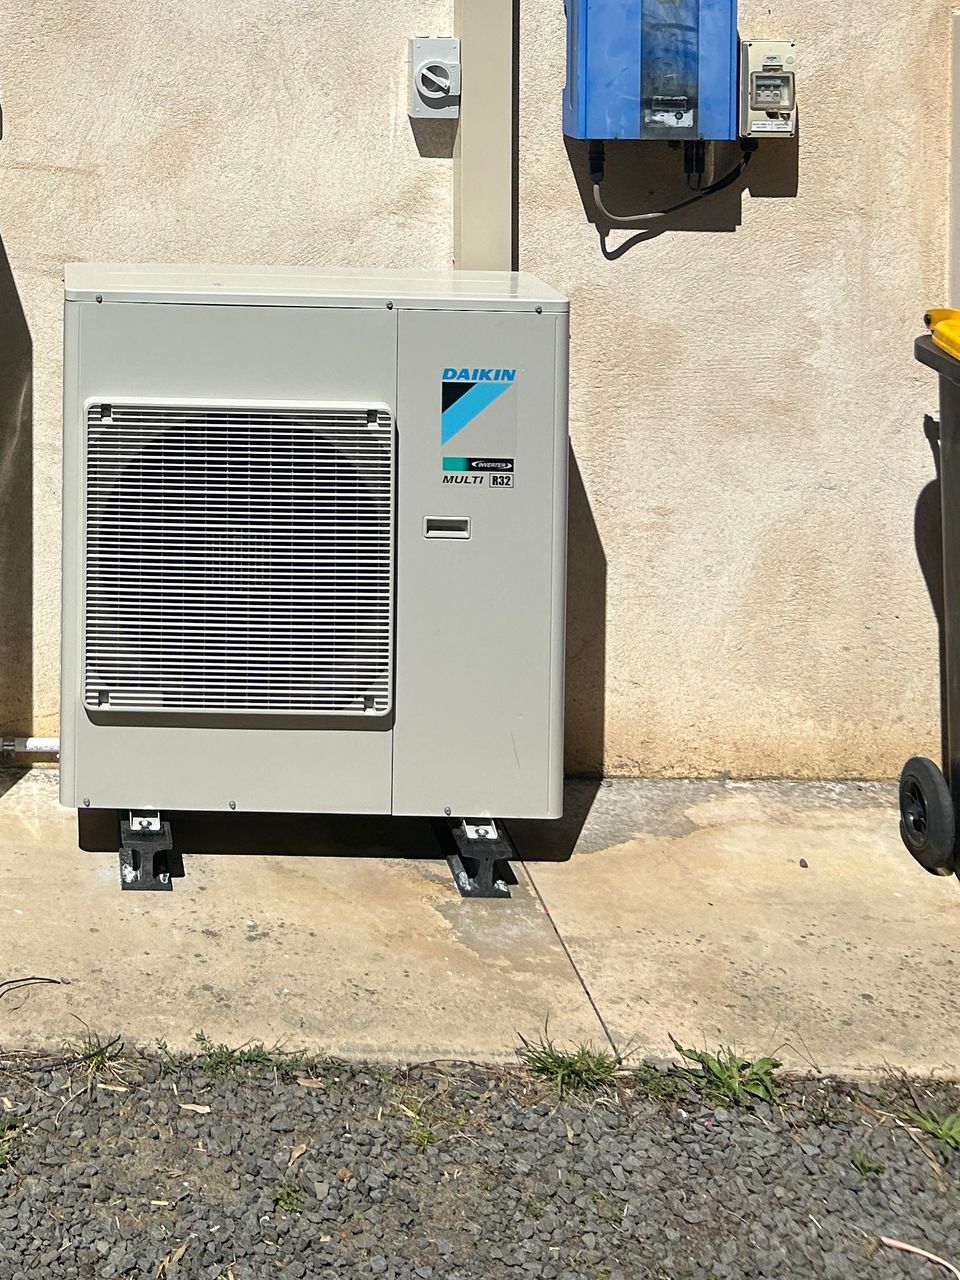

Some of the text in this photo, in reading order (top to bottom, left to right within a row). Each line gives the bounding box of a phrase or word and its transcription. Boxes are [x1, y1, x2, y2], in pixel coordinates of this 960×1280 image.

[442, 367, 516, 381] DAIKIN
[442, 475, 511, 486] MULTI R32
